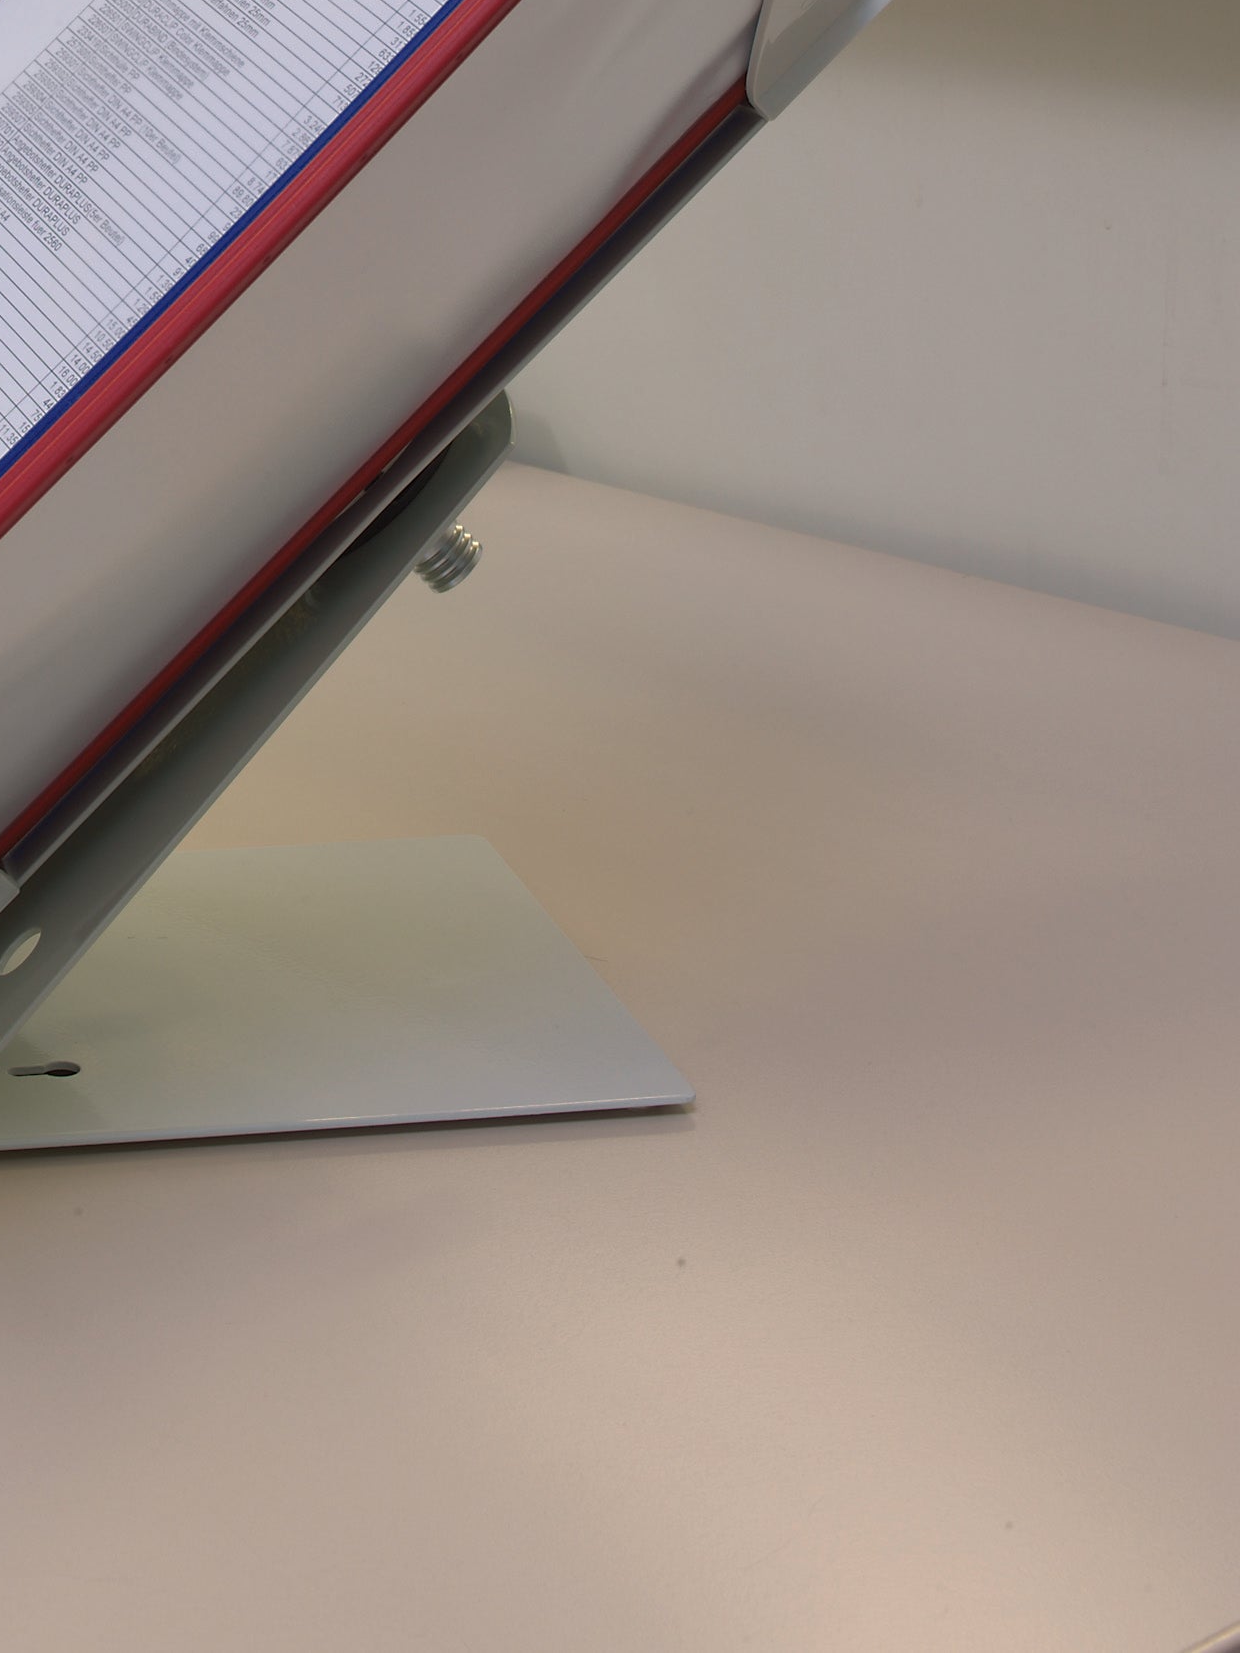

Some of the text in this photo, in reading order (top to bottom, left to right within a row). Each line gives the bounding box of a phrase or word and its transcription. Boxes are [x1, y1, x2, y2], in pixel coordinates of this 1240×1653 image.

[235, 16, 261, 38] 25mm
[246, 4, 272, 27] 25mm
[197, 25, 247, 69] Klemmschiene
[10, 133, 58, 181] Angebotshefter
[84, 160, 99, 174] PP
[95, 148, 110, 163] PP
[0, 145, 47, 193] Angebotshefter
[41, 185, 81, 225] DURAPLUS
[64, 163, 78, 176] A4
[73, 172, 88, 186] PP
[31, 197, 71, 237] DURAPLUS
[30, 219, 48, 237] fuer
[42, 231, 63, 252] 2560
